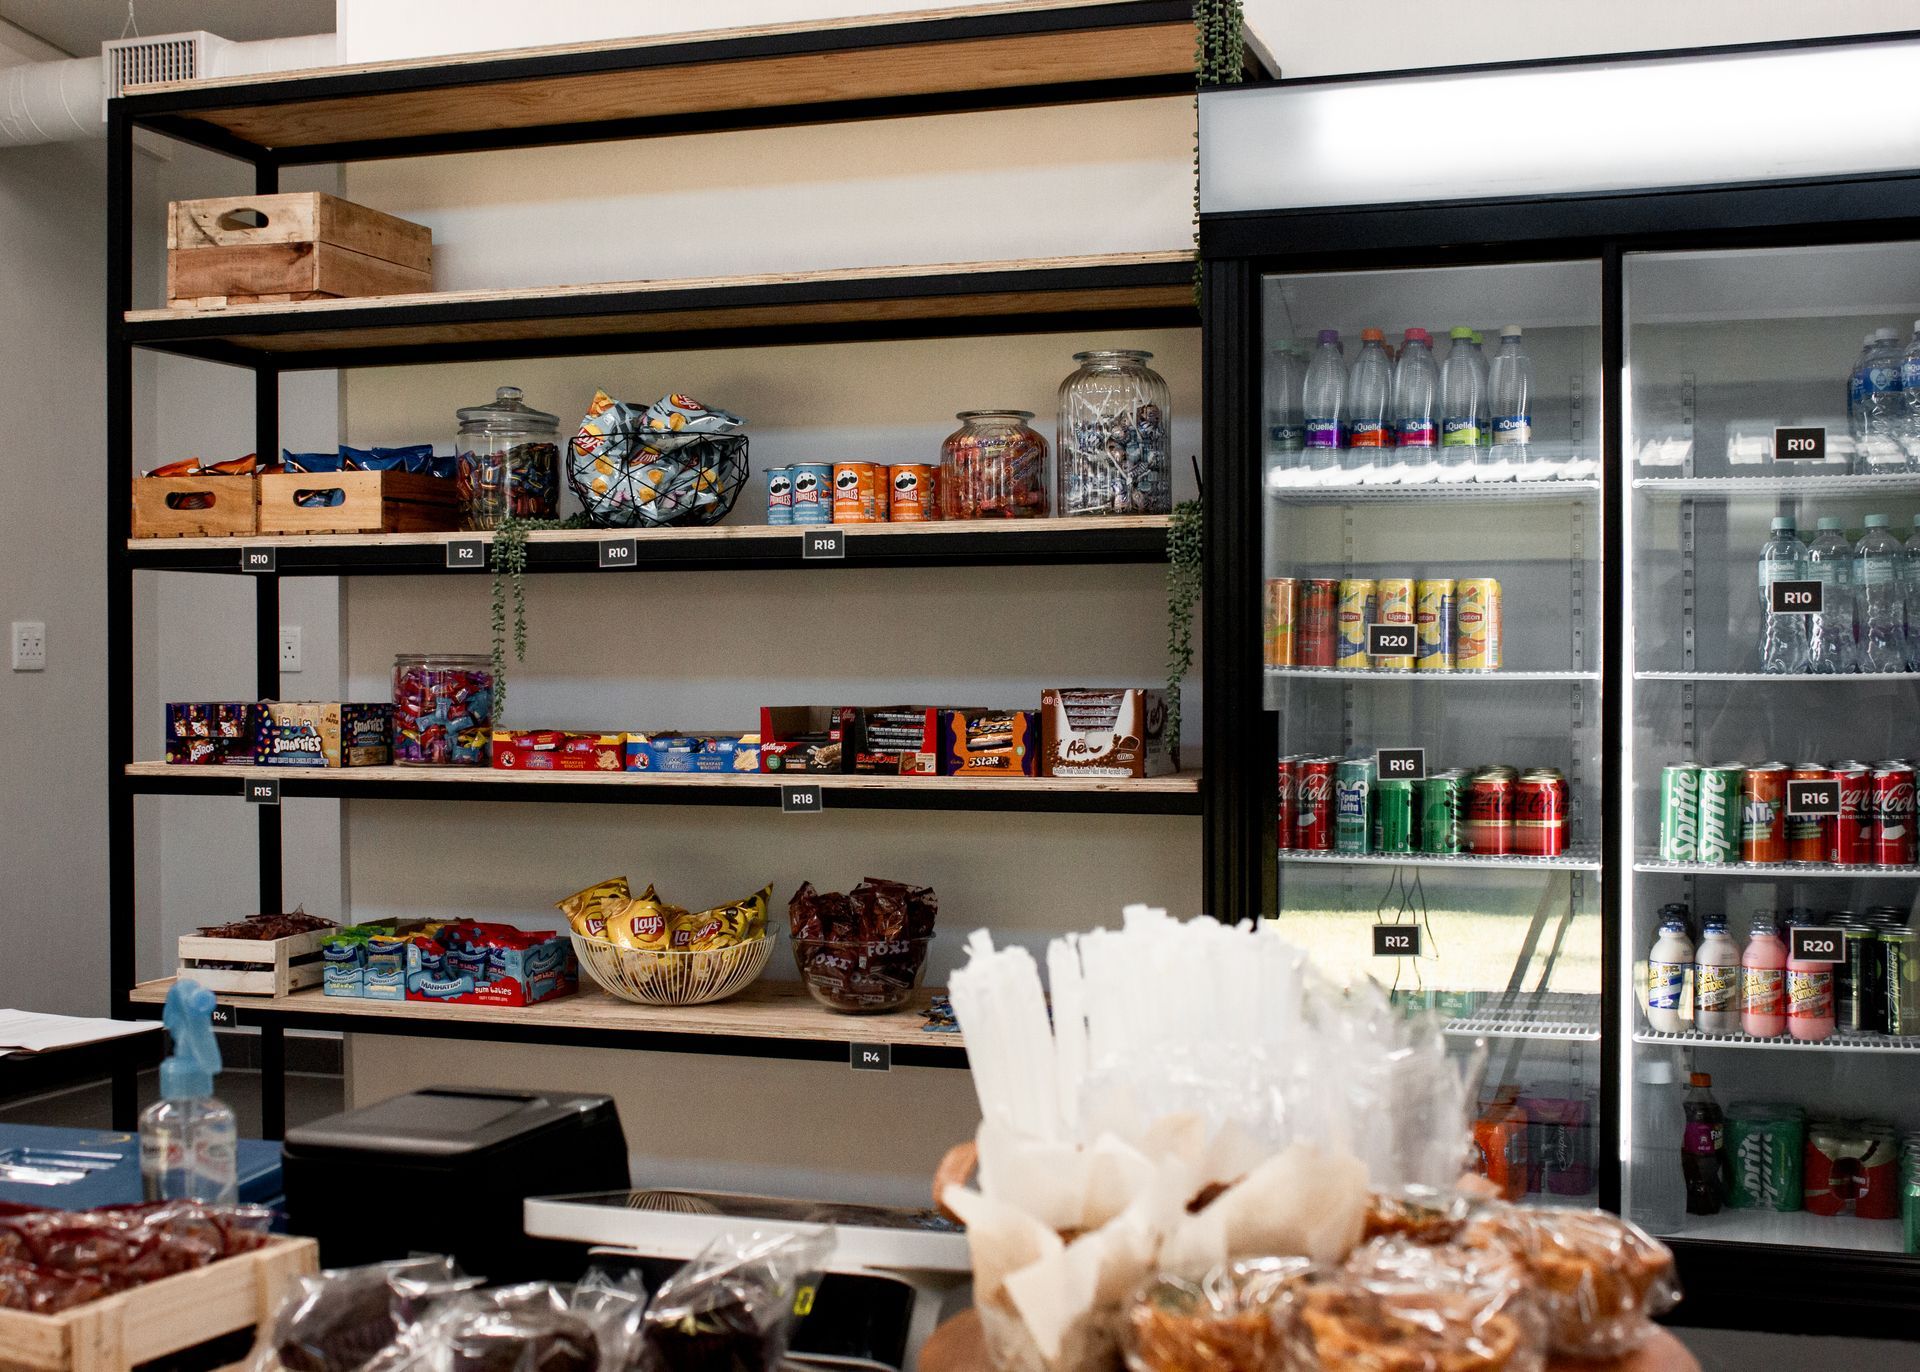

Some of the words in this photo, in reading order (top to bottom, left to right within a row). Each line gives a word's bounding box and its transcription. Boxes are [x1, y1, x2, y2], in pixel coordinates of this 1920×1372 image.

[1787, 439, 1815, 451] R10
[770, 494, 791, 506] PRINGLES
[795, 490, 818, 504] PRINGLES
[836, 488, 858, 500] PRINGLES
[814, 539, 835, 550] R18
[459, 548, 474, 558] R2
[608, 547, 628, 559] R10
[250, 554, 268, 565] R10
[1784, 592, 1812, 604] R10
[1388, 613, 1410, 622] Lipton
[1379, 635, 1408, 647] R20
[1042, 696, 1052, 705] 40
[273, 736, 322, 753] SMARTIES
[761, 743, 787, 753] Kellogg's
[191, 744, 215, 762] ASTROS
[1390, 760, 1415, 771] R16
[254, 786, 272, 797] R15
[792, 793, 813, 804] R18
[1802, 793, 1830, 805] R16
[1671, 772, 1698, 861] Sprite
[1700, 773, 1731, 864] Sprite
[634, 914, 664, 936] Lay's
[1384, 936, 1410, 948] R12
[1803, 940, 1834, 953] R20
[420, 978, 462, 992] MANHATTAN
[490, 987, 512, 996] babies
[213, 1011, 227, 1021] R4
[863, 1051, 880, 1063] R4
